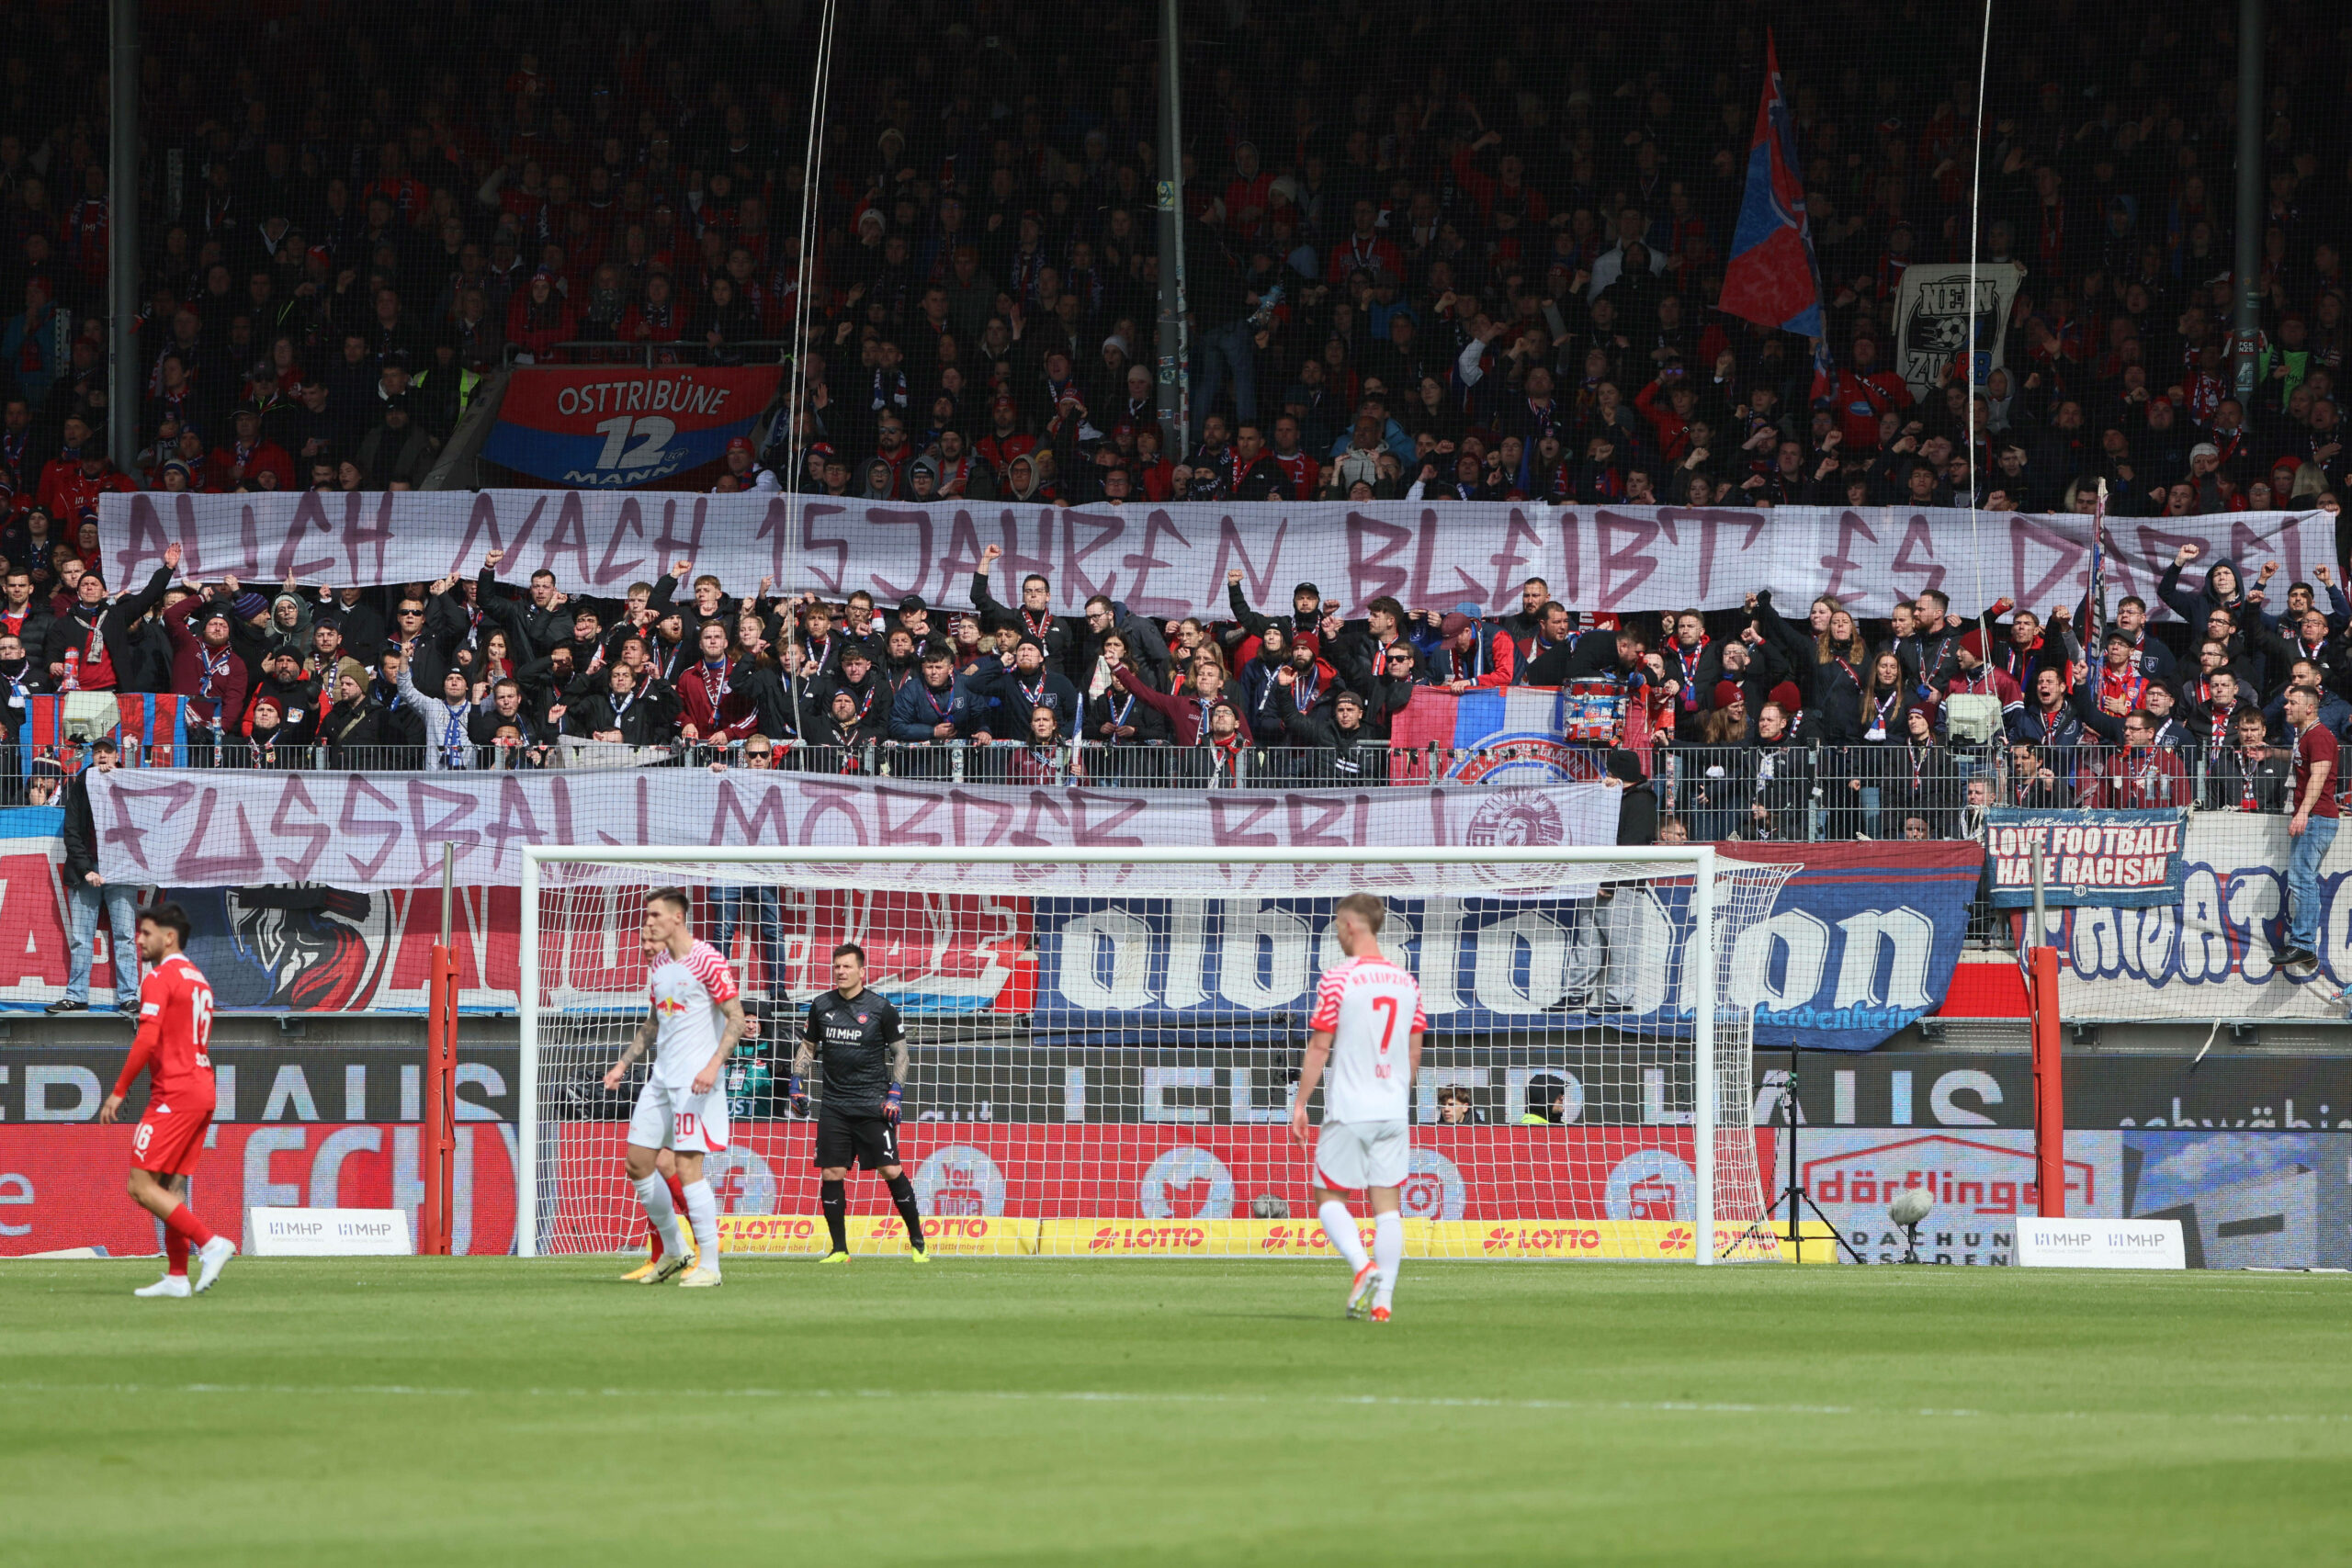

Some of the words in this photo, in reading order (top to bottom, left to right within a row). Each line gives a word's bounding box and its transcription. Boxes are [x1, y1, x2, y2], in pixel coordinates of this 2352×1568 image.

[1918, 279, 1996, 316] NEIN
[1905, 351, 1950, 386] ZU
[558, 375, 730, 415] OSTTRIBÜNE
[595, 415, 676, 470] 12
[563, 463, 679, 485] MANN
[117, 491, 395, 592] AUCH
[448, 487, 707, 590] NACH
[756, 496, 848, 594] 15
[865, 505, 1287, 617] JAHREN
[1346, 506, 1765, 620] BLEIBT
[1820, 510, 1946, 604] ES
[2009, 514, 2305, 619] DABEI
[1988, 827, 2049, 856] LOVE
[2052, 825, 2178, 855] FOOTBALL
[2061, 855, 2167, 886] RACISM
[1369, 972, 1410, 987] LEIPZIG
[837, 1029, 863, 1041] MHP
[1373, 996, 1397, 1055] 7
[674, 1112, 695, 1135] 30
[883, 1130, 892, 1150] 1
[287, 1223, 322, 1235] MHP
[356, 1224, 391, 1236] MHP
[735, 1220, 815, 1240] LOTTO
[922, 1219, 989, 1238] OTTO
[1123, 1227, 1205, 1249] LOTTO
[1295, 1228, 1376, 1248] LOO
[1518, 1229, 1601, 1250] LOTTO
[1713, 1230, 1780, 1251] OTTO
[2053, 1234, 2092, 1247] MHP
[2127, 1234, 2165, 1247] MHP
